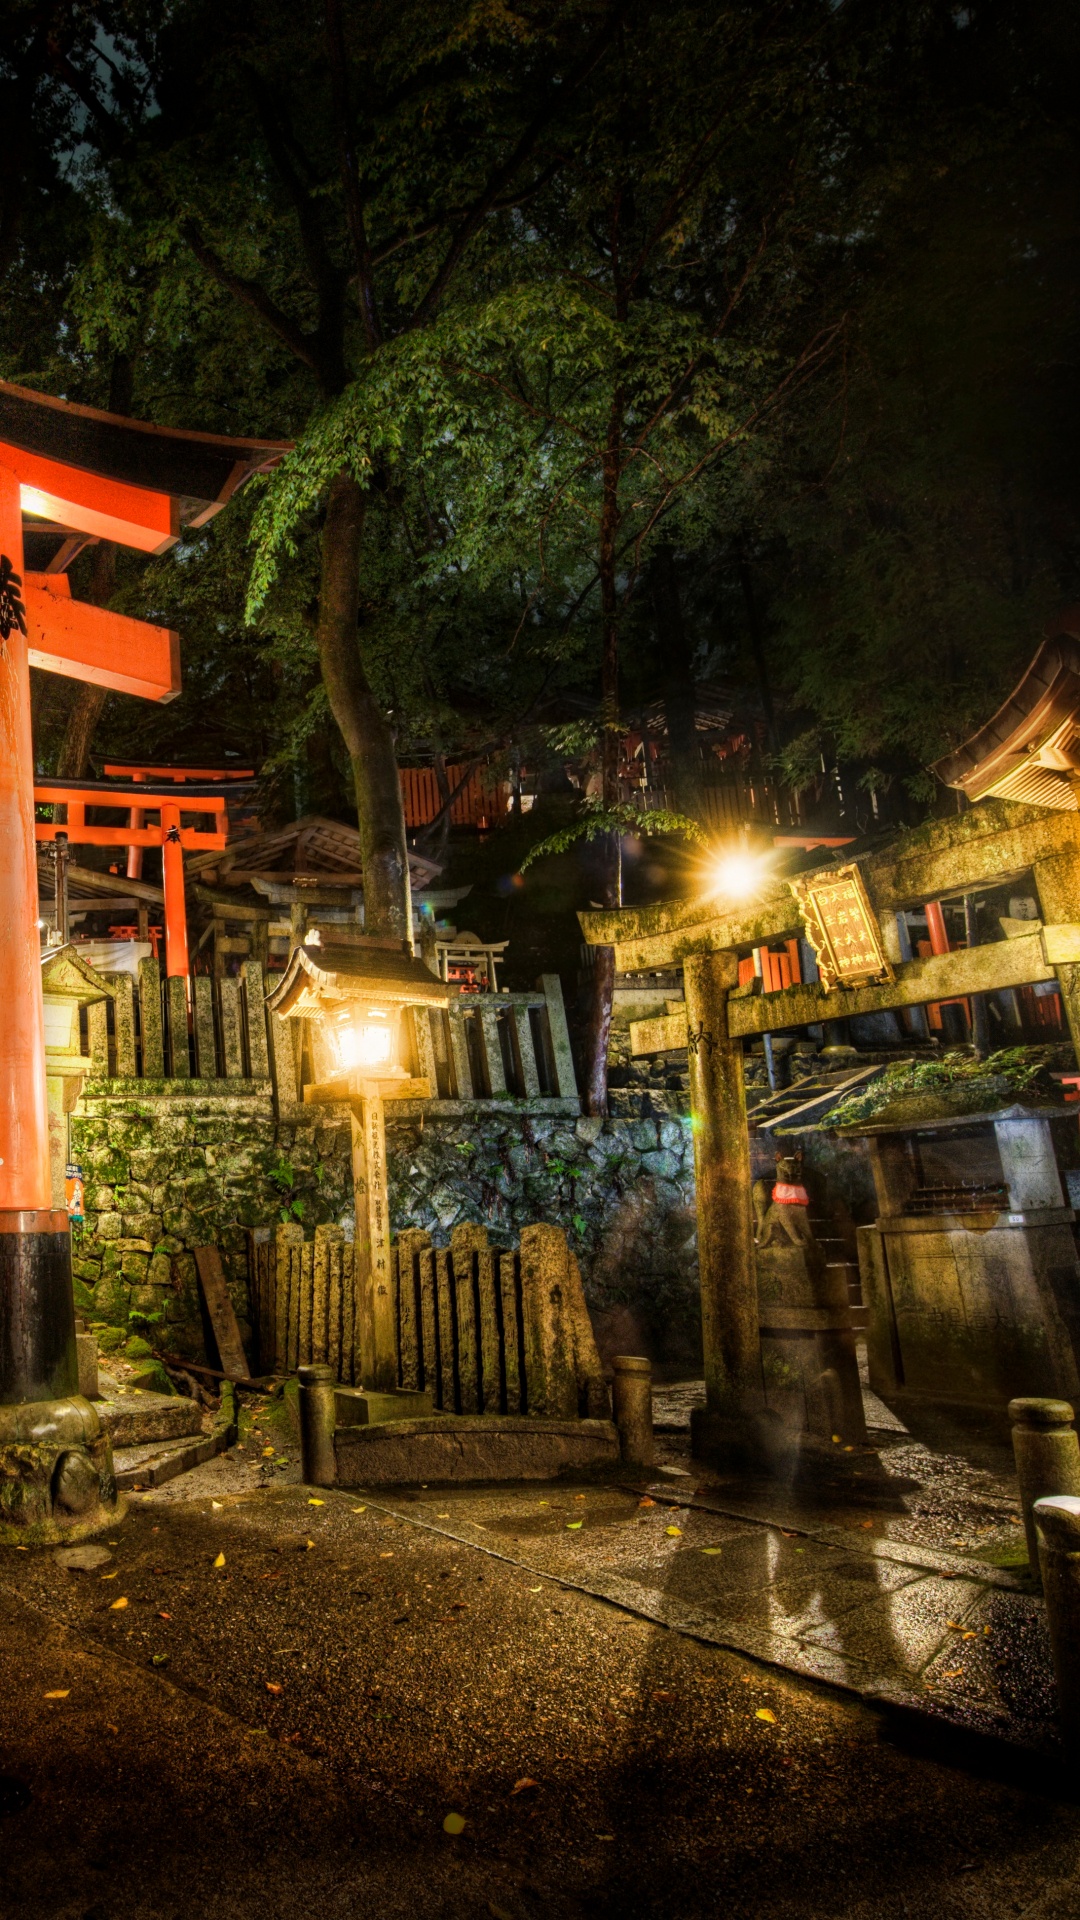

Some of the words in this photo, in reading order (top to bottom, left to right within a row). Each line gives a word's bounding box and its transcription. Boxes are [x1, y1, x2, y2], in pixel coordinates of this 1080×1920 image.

[165, 824, 181, 844] 奉
[830, 890, 864, 965] 大岩大神
